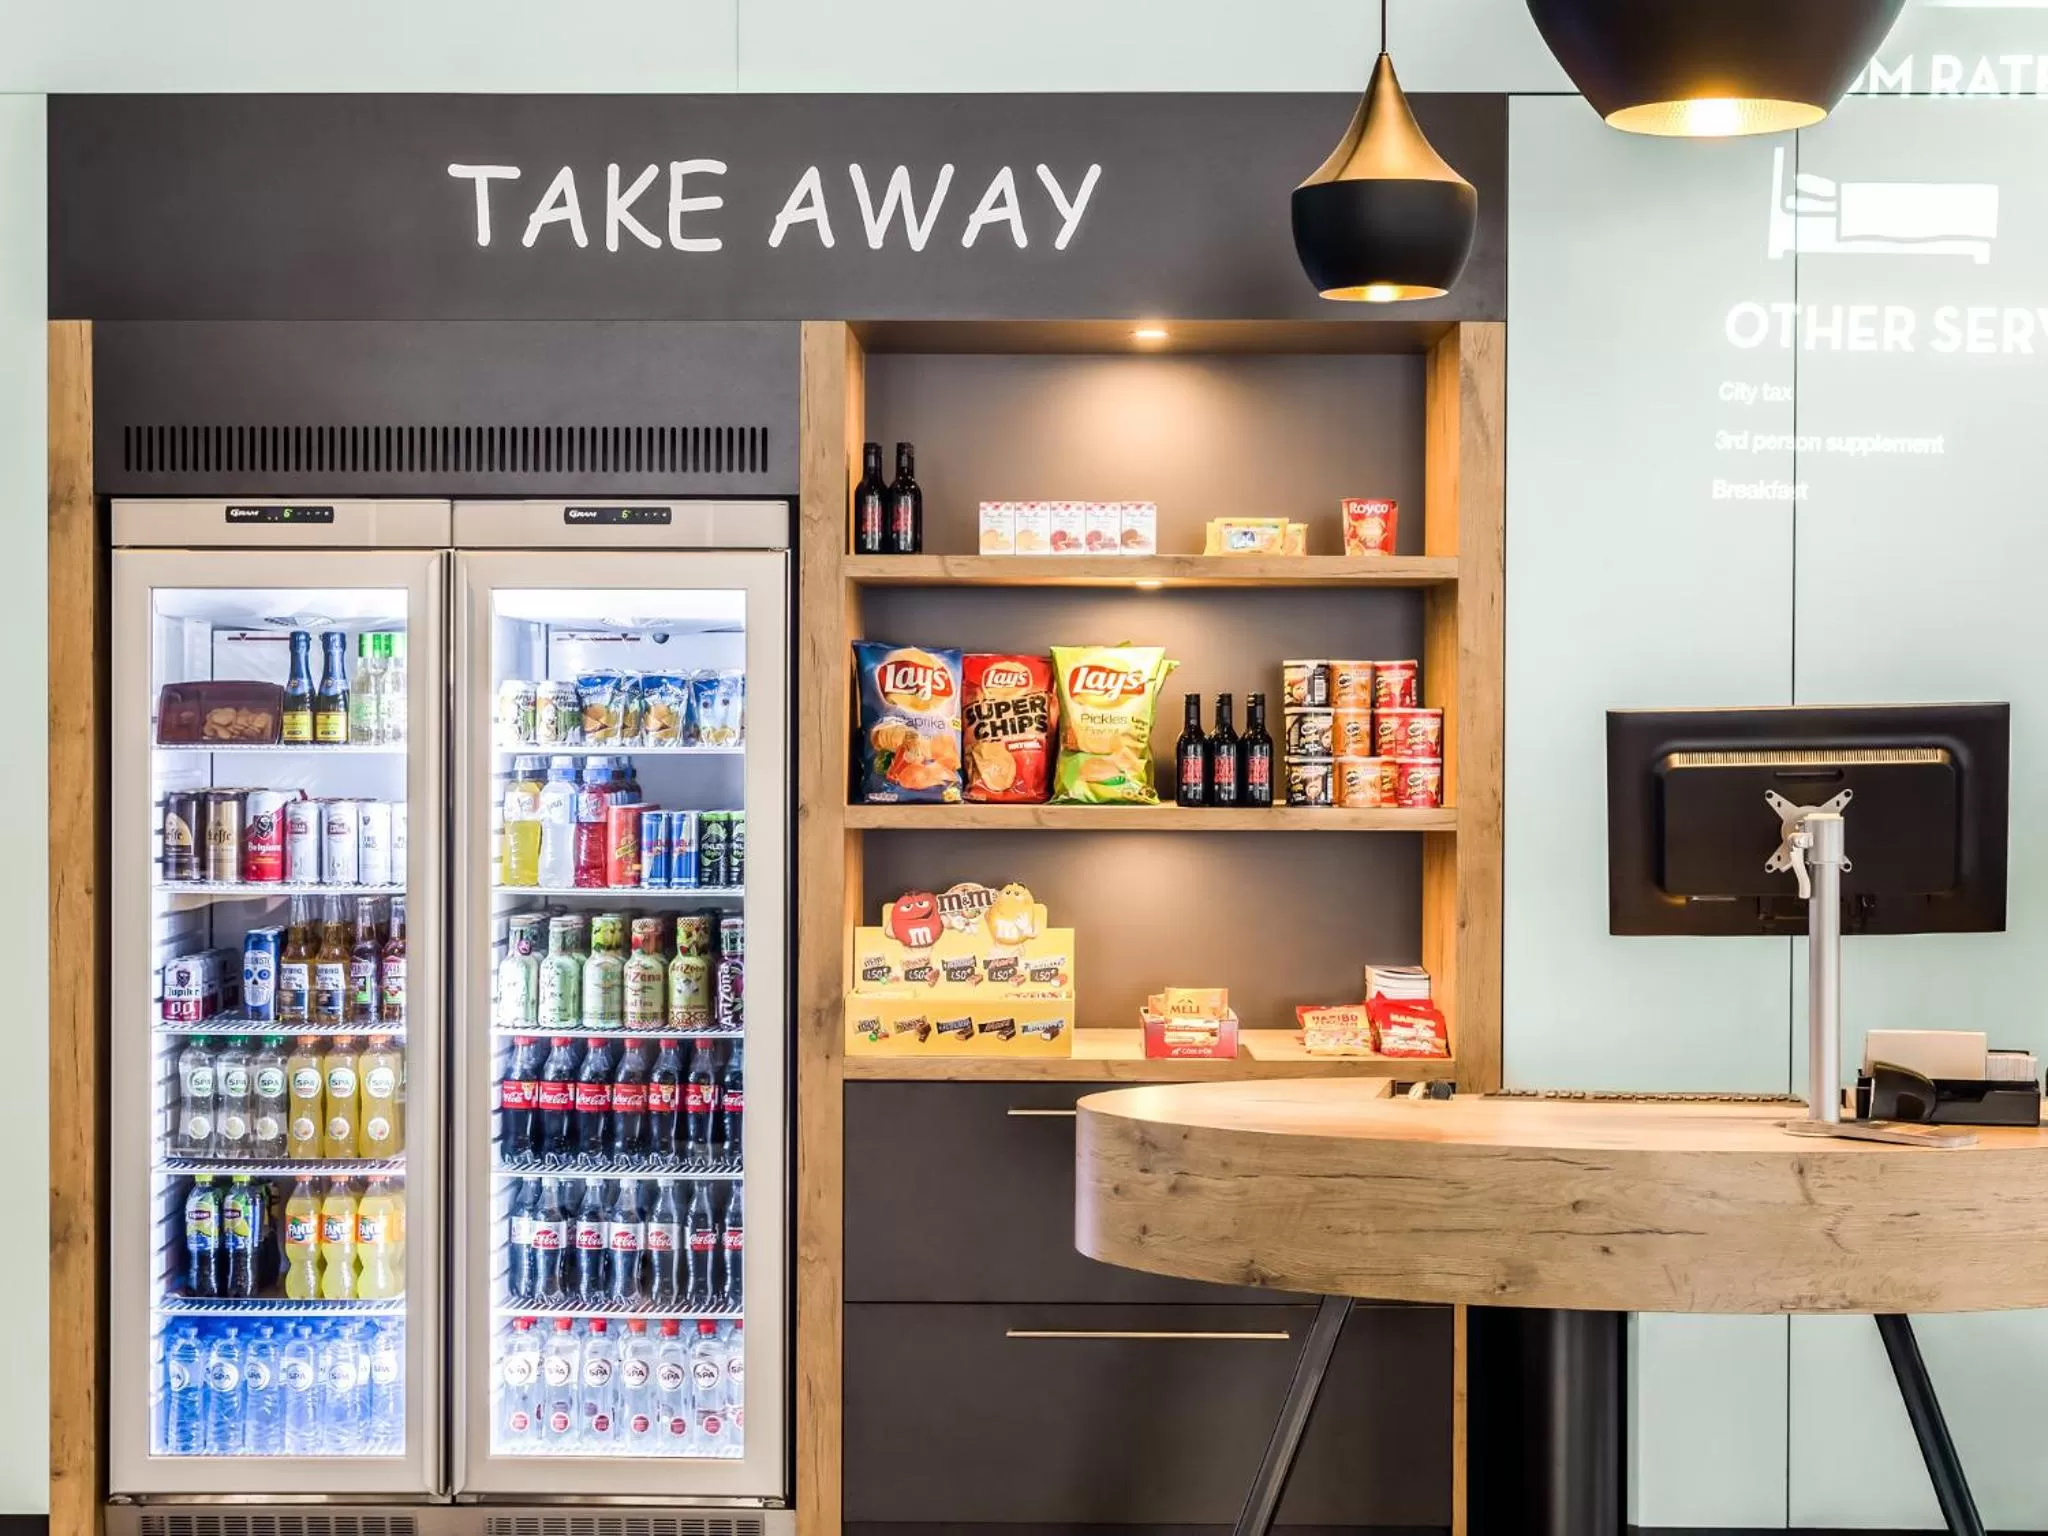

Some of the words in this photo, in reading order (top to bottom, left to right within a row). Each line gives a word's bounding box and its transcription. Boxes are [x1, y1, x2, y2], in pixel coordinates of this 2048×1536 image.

[447, 159, 728, 252] TAKE
[768, 162, 1102, 252] AWAY
[1724, 300, 1916, 352] OTHER
[1718, 381, 1758, 404] City
[1761, 382, 1794, 402] tax
[1714, 430, 1749, 452] 3rd
[1753, 433, 1822, 455] person
[1825, 433, 1945, 457] supplement
[1711, 479, 1810, 501] Breakfast
[1349, 502, 1389, 515] Royco
[884, 663, 950, 700] Lay's
[985, 669, 1029, 689] Lay's
[1073, 666, 1148, 700] Lay's
[964, 693, 1047, 726] SUPER
[1080, 713, 1128, 726] Pickles
[899, 714, 946, 732] Paprika
[974, 715, 1048, 743] CHIPS
[1170, 1005, 1200, 1014] MELI
